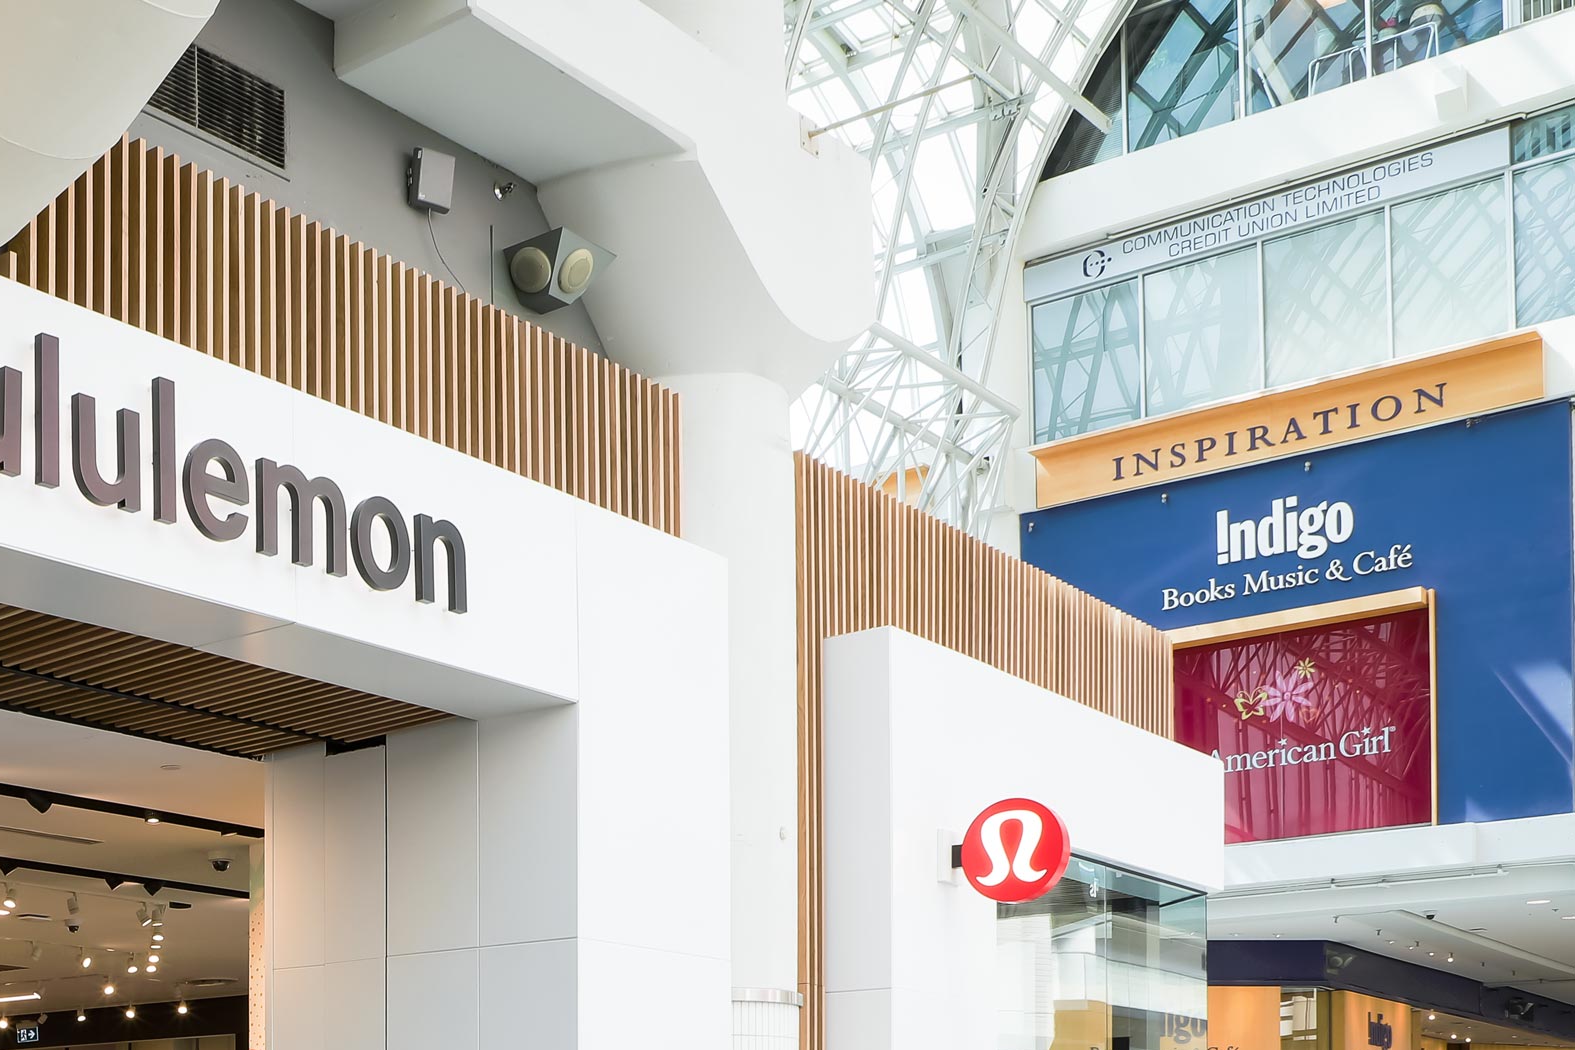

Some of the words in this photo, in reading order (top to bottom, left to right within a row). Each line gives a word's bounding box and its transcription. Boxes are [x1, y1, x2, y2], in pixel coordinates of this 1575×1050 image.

[1122, 197, 1275, 255] COMMUNICATION
[1281, 151, 1434, 208] TECHNOLOGIES
[1168, 225, 1232, 258] CREDIT
[1237, 210, 1298, 239] UNION
[1304, 184, 1382, 221] LIMITED
[1112, 382, 1448, 481] INSPIRATION
[1162, 577, 1236, 612] Books
[1242, 566, 1320, 598] Music
[1325, 559, 1352, 583] &
[1353, 543, 1413, 578] Café
[1339, 726, 1391, 758] Girl
